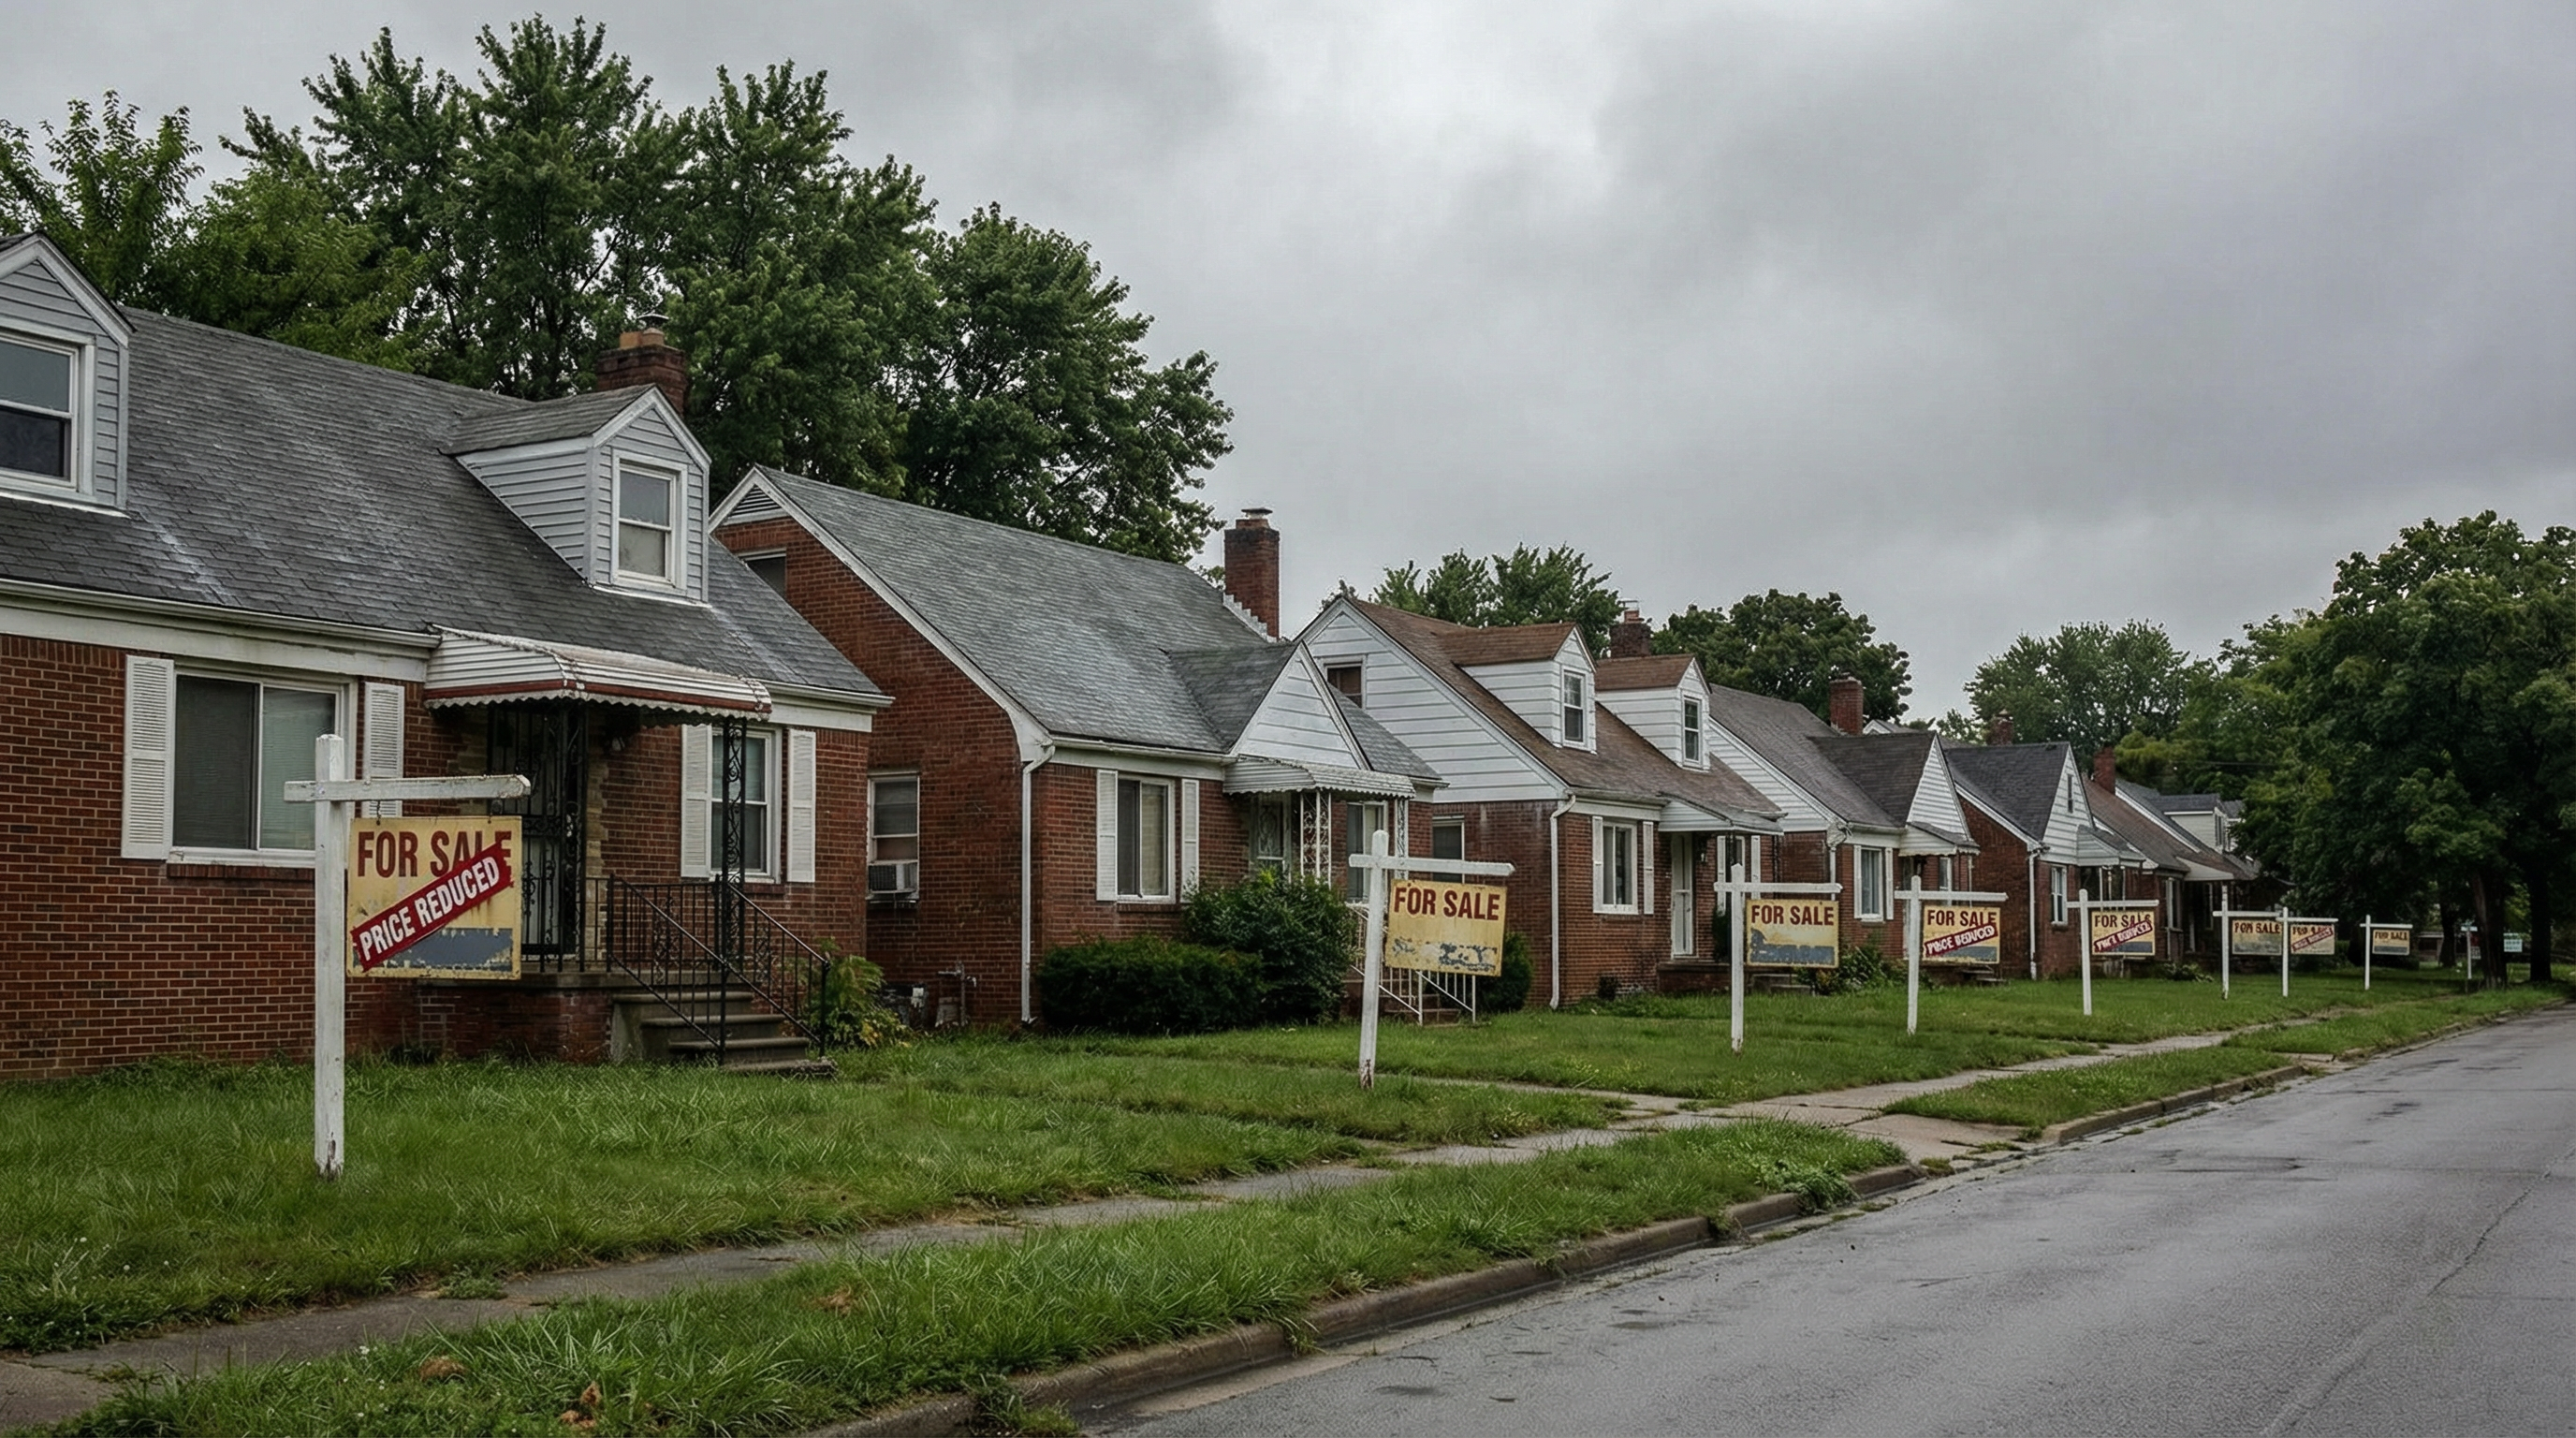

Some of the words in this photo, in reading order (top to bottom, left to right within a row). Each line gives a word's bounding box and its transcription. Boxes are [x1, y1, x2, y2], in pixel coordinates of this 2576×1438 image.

[358, 830, 418, 878] FOR
[359, 906, 416, 961] PRICE
[414, 856, 500, 928] REDUCED
[1394, 887, 1436, 915] FOR
[1443, 890, 1500, 920] SALE
[1751, 905, 1784, 924] FOR
[1790, 905, 1834, 925] SALE
[1927, 910, 1954, 926] FOR
[2095, 915, 2117, 928] FOR
